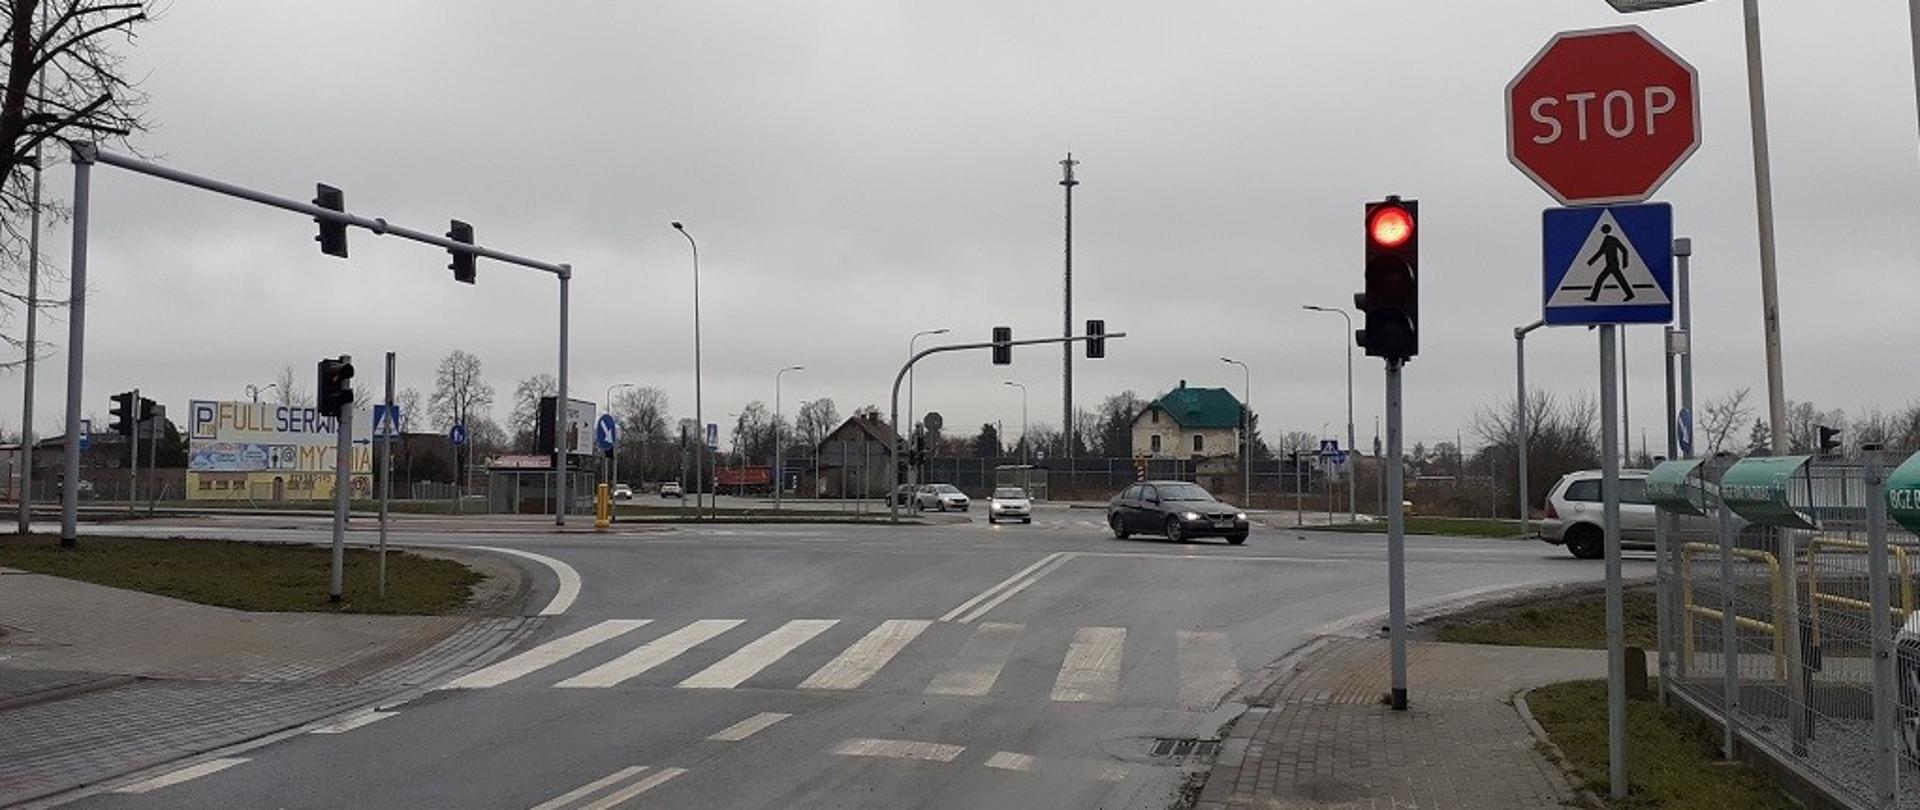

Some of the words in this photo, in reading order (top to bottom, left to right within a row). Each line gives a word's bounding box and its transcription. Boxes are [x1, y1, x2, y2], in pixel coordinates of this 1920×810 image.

[1529, 86, 1677, 145] STOP
[219, 402, 273, 432] FULL
[276, 405, 341, 434] SERWI
[300, 445, 371, 470] MYJIA
